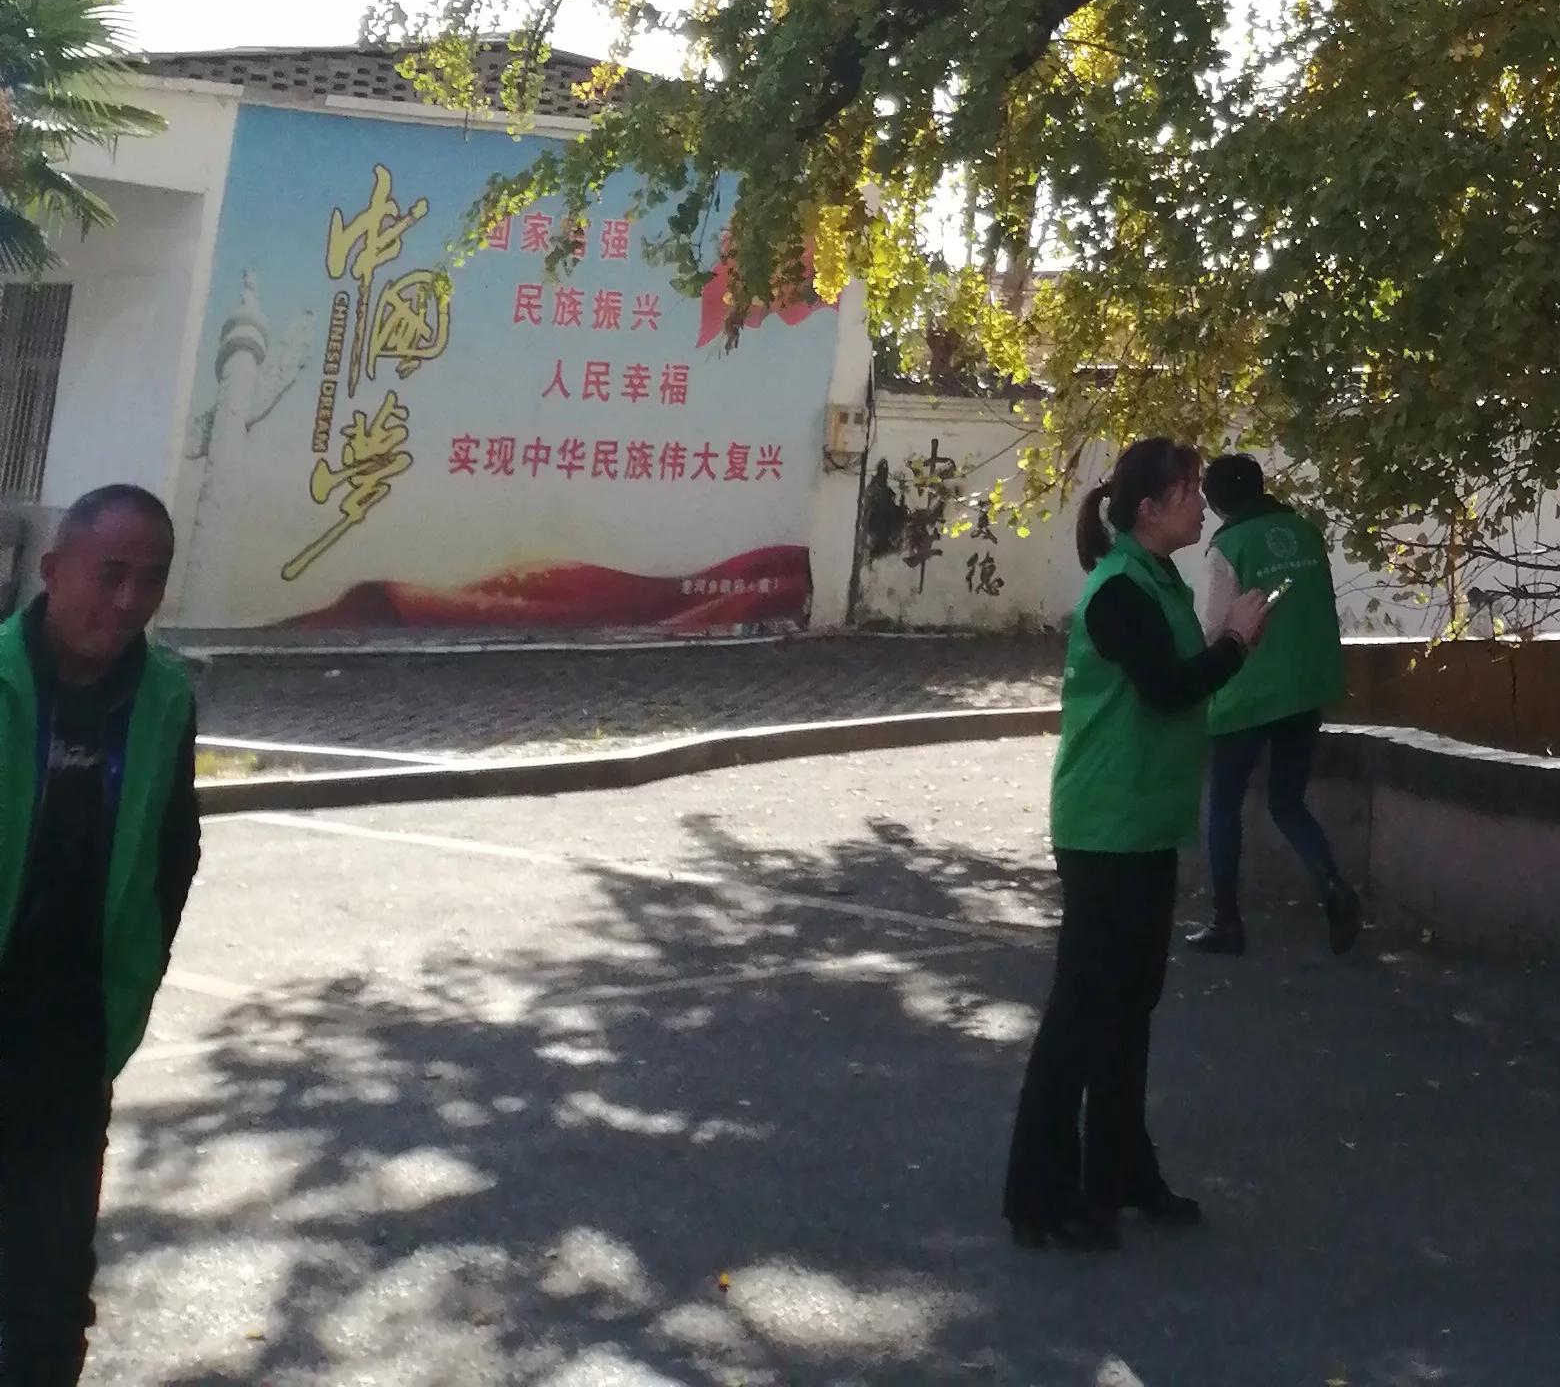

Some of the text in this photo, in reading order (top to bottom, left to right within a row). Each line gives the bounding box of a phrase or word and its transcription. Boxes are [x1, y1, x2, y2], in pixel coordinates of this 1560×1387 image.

[512, 283, 663, 331] 民族振兴
[311, 290, 350, 453] CHINESE DREAM
[541, 358, 691, 405] 人民幸福
[448, 433, 785, 483] 实现中华民族伟大复兴
